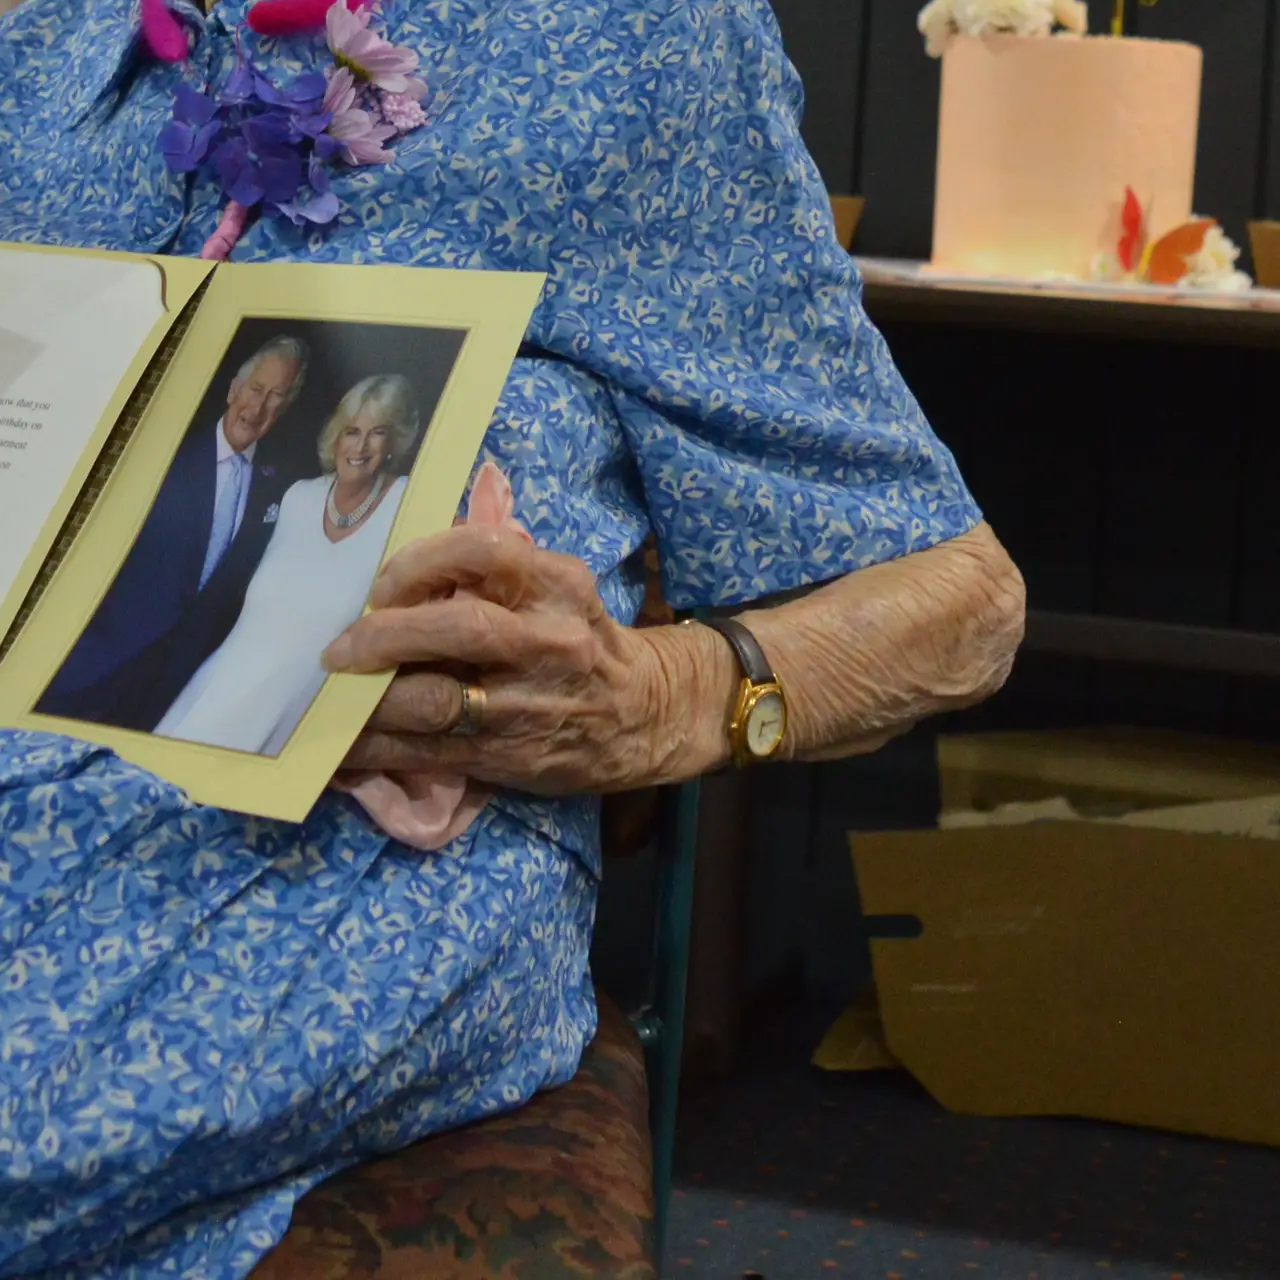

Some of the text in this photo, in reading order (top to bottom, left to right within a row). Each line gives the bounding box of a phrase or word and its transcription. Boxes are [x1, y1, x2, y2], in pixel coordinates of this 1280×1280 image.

[15, 396, 34, 407] that
[33, 401, 51, 411] you
[30, 421, 43, 430] on
